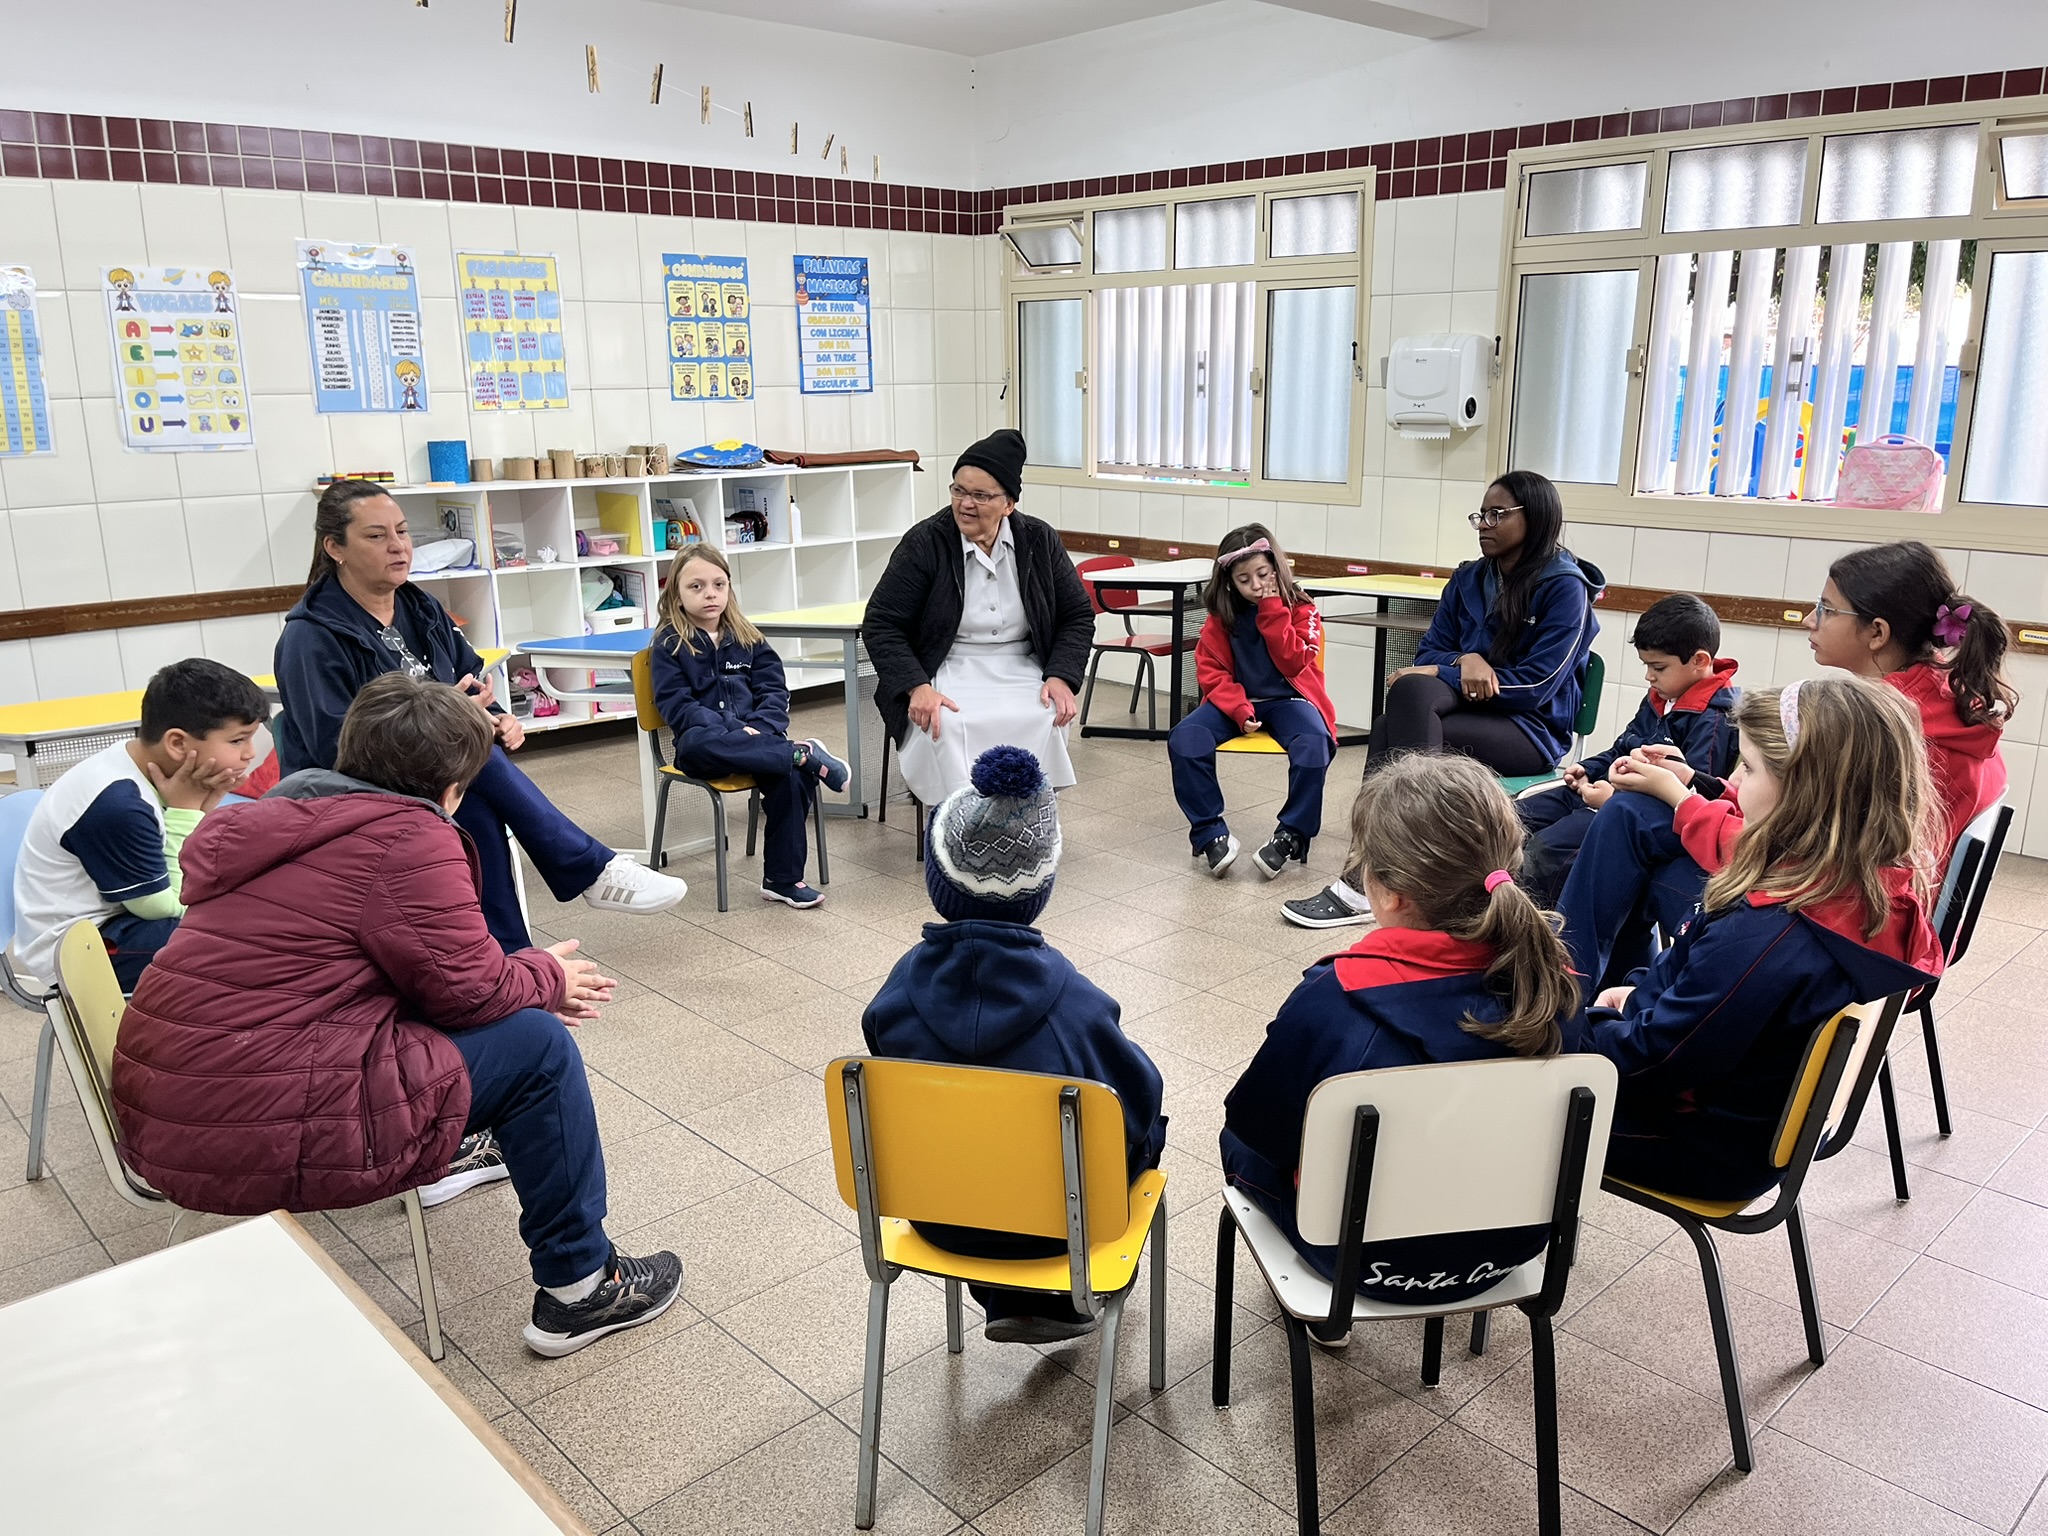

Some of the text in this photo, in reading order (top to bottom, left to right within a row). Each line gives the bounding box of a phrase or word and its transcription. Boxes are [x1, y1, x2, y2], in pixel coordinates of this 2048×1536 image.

[803, 259, 860, 274] PALAVRAS
[807, 277, 857, 294] MÁGICAS
[135, 293, 213, 313] VOGAIS
[812, 303, 854, 312] POR FAVOR
[807, 315, 861, 325] OBRIGADO (A)
[126, 321, 141, 338] A
[811, 328, 860, 339] COM LICENÇA
[819, 341, 850, 349] BOM DIA
[130, 345, 144, 361] E
[817, 354, 856, 362] BOA TARDE
[136, 368, 143, 385] I
[817, 367, 856, 376] BOA NOITE
[813, 379, 859, 389] DESCULPE-ME
[135, 392, 152, 408] O
[140, 417, 155, 433] U
[1363, 1261, 1460, 1291] Santa
